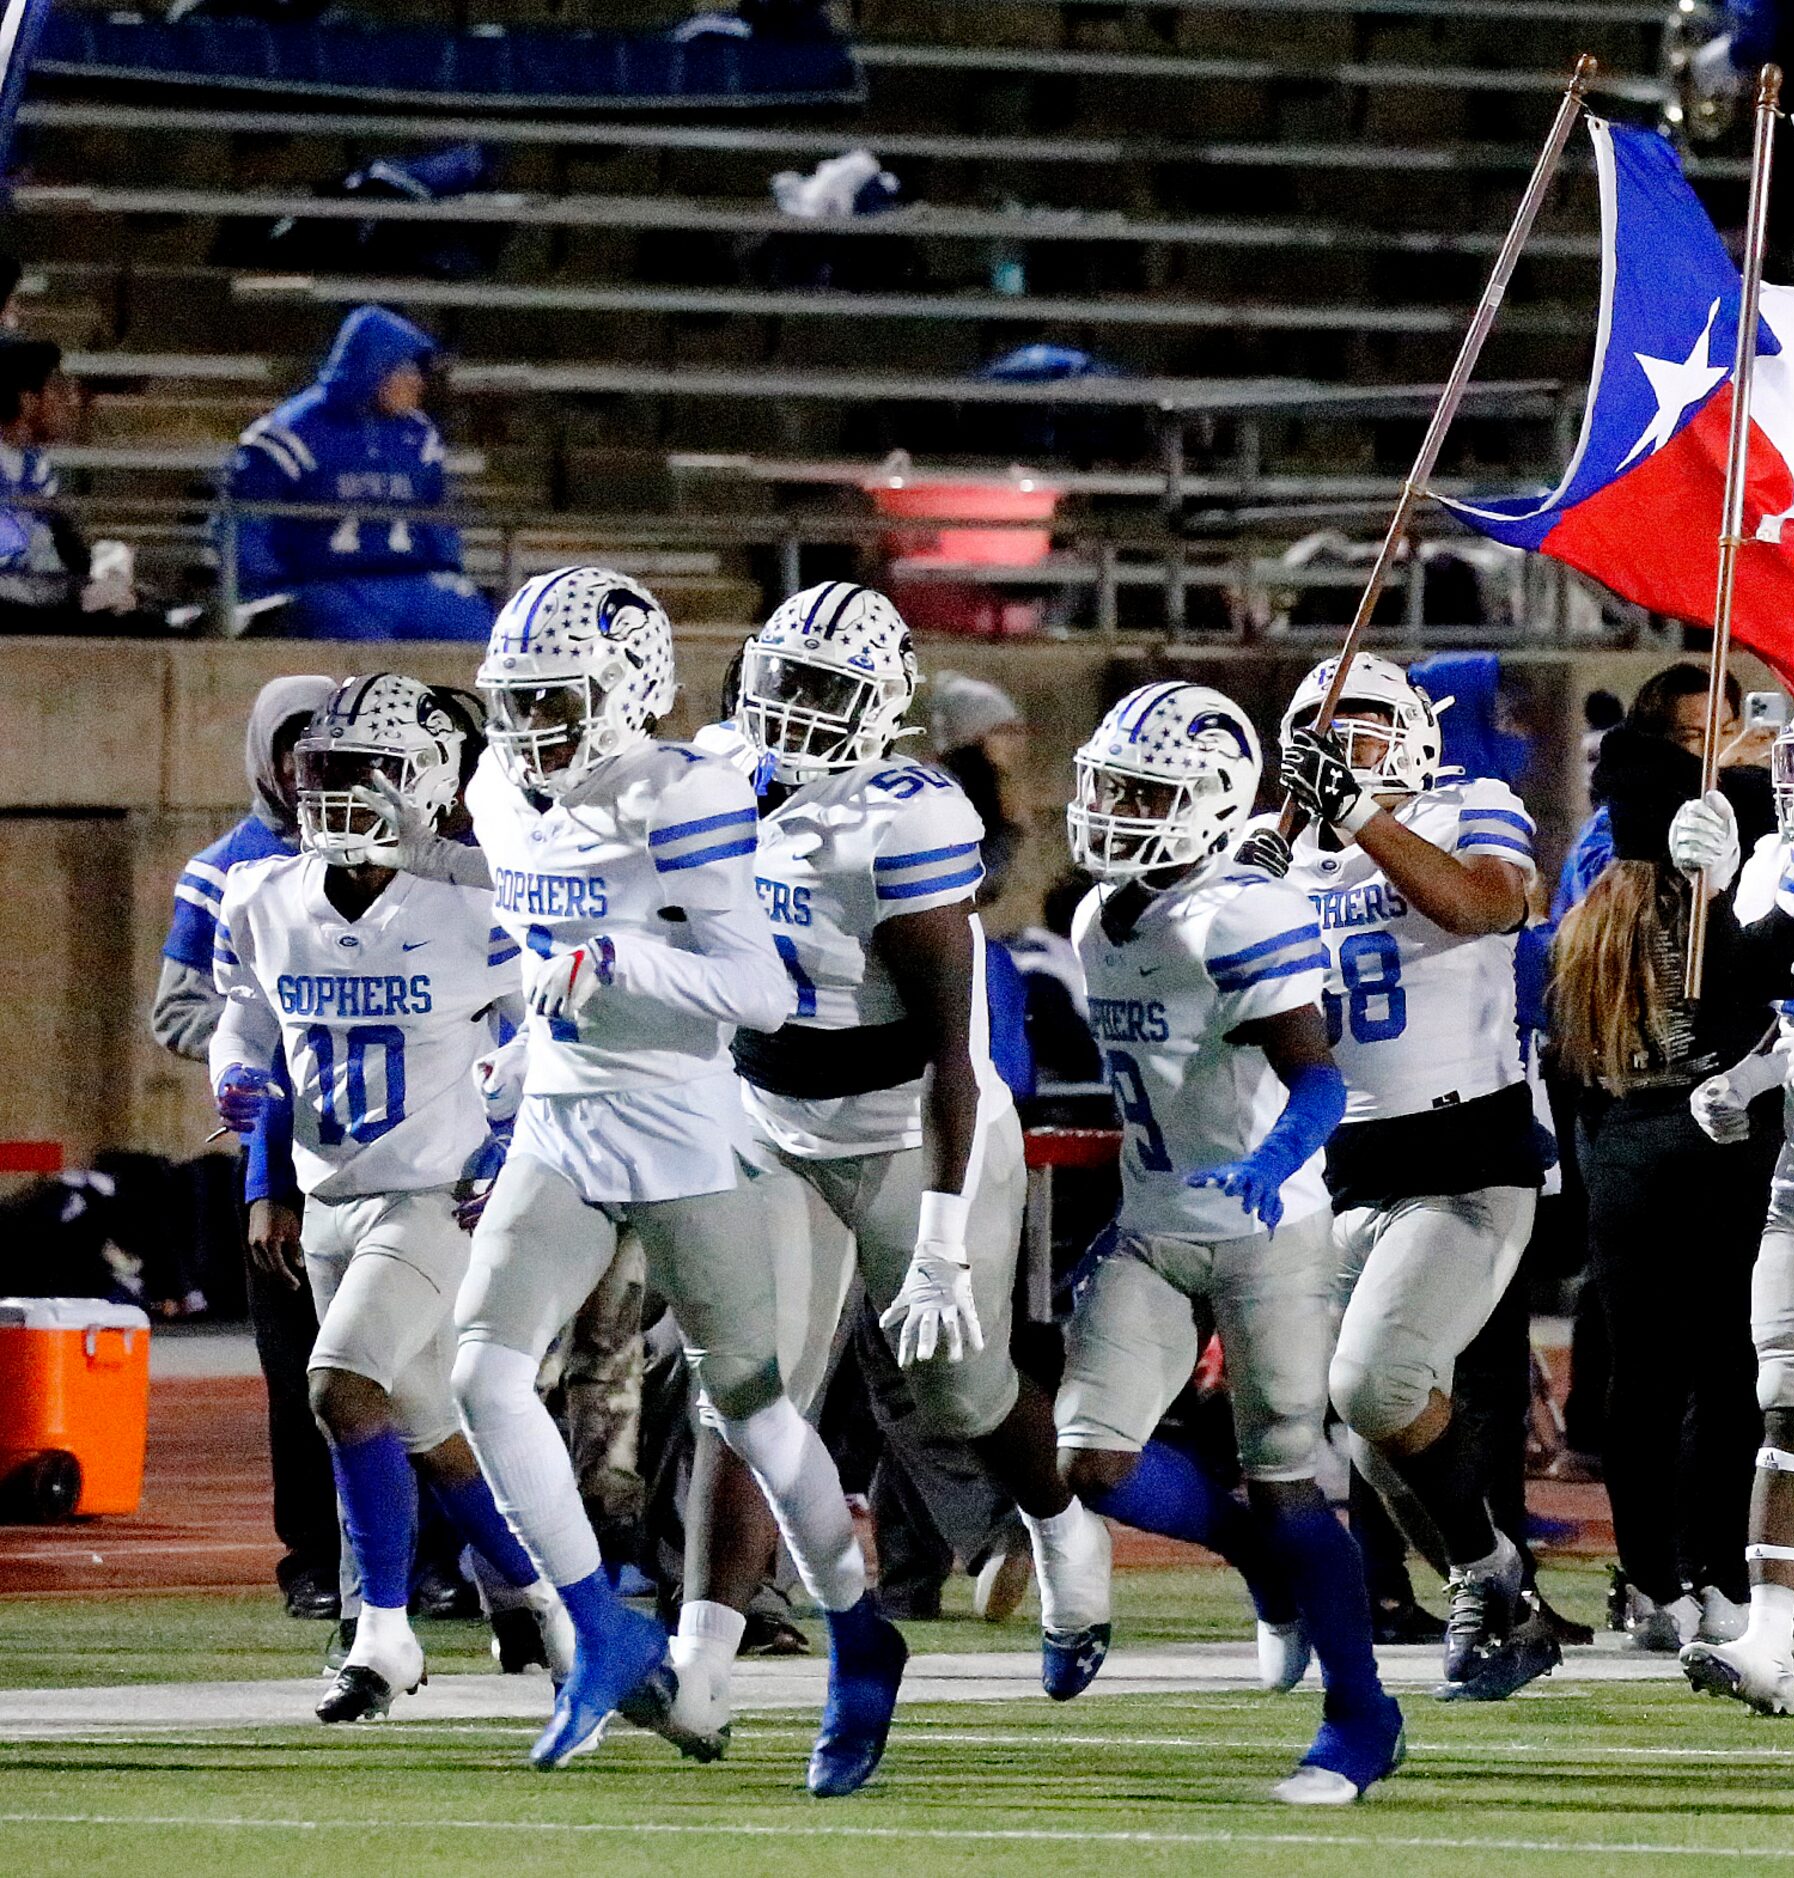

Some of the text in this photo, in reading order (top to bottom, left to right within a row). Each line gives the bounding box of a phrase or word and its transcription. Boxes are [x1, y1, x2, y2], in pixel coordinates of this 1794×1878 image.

[495, 868, 608, 917] GOPHERS
[276, 974, 433, 1017] GOPHERS
[307, 1024, 406, 1145] 10
